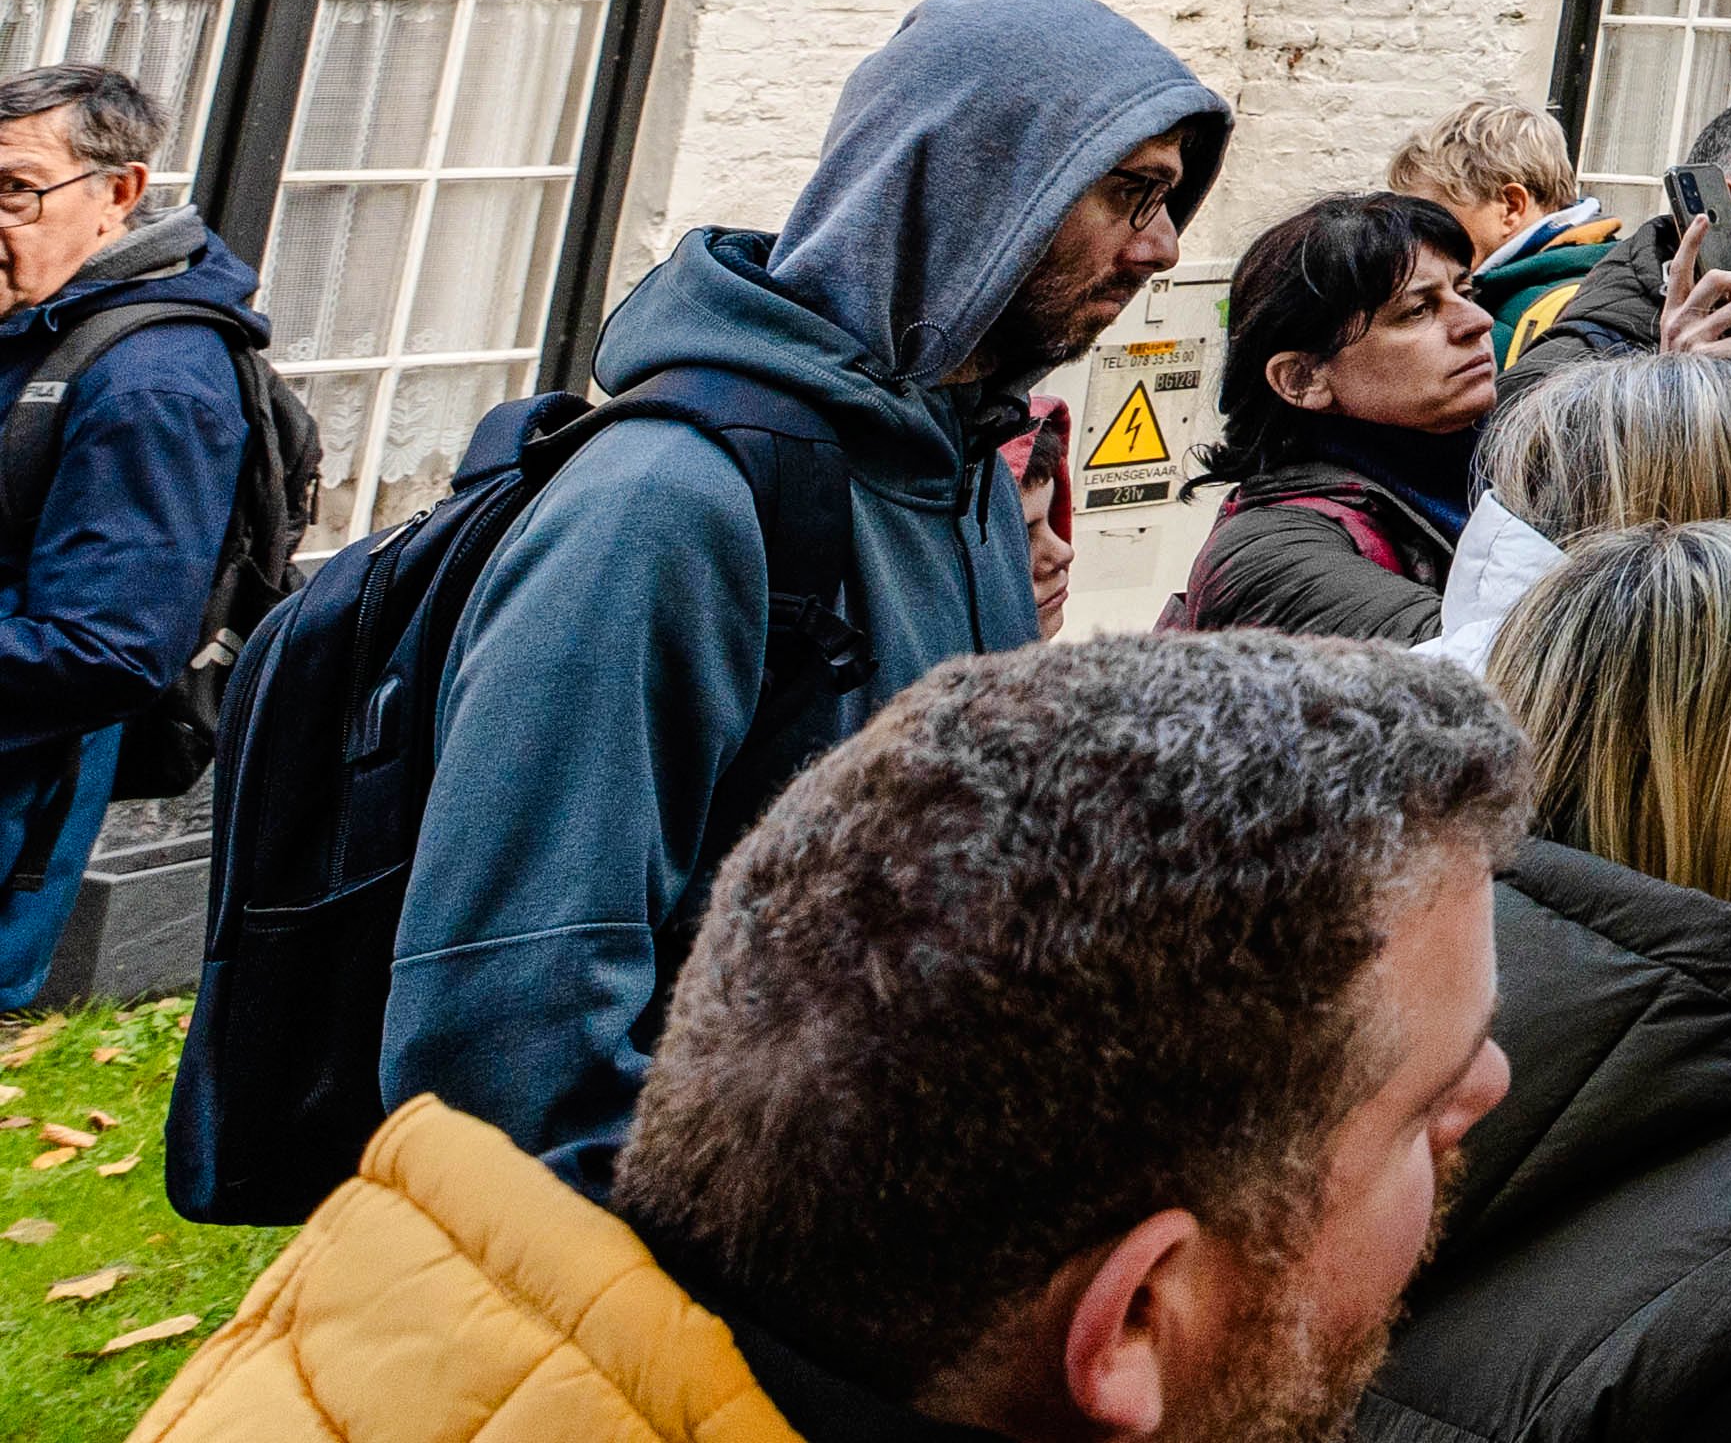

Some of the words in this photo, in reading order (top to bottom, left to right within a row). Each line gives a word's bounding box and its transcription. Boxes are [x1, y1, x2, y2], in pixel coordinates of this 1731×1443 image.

[1130, 355, 1149, 367] 078
[1152, 353, 1165, 365] 35
[1168, 352, 1180, 364] 35
[1084, 465, 1178, 486] LEVENSGEVAAR
